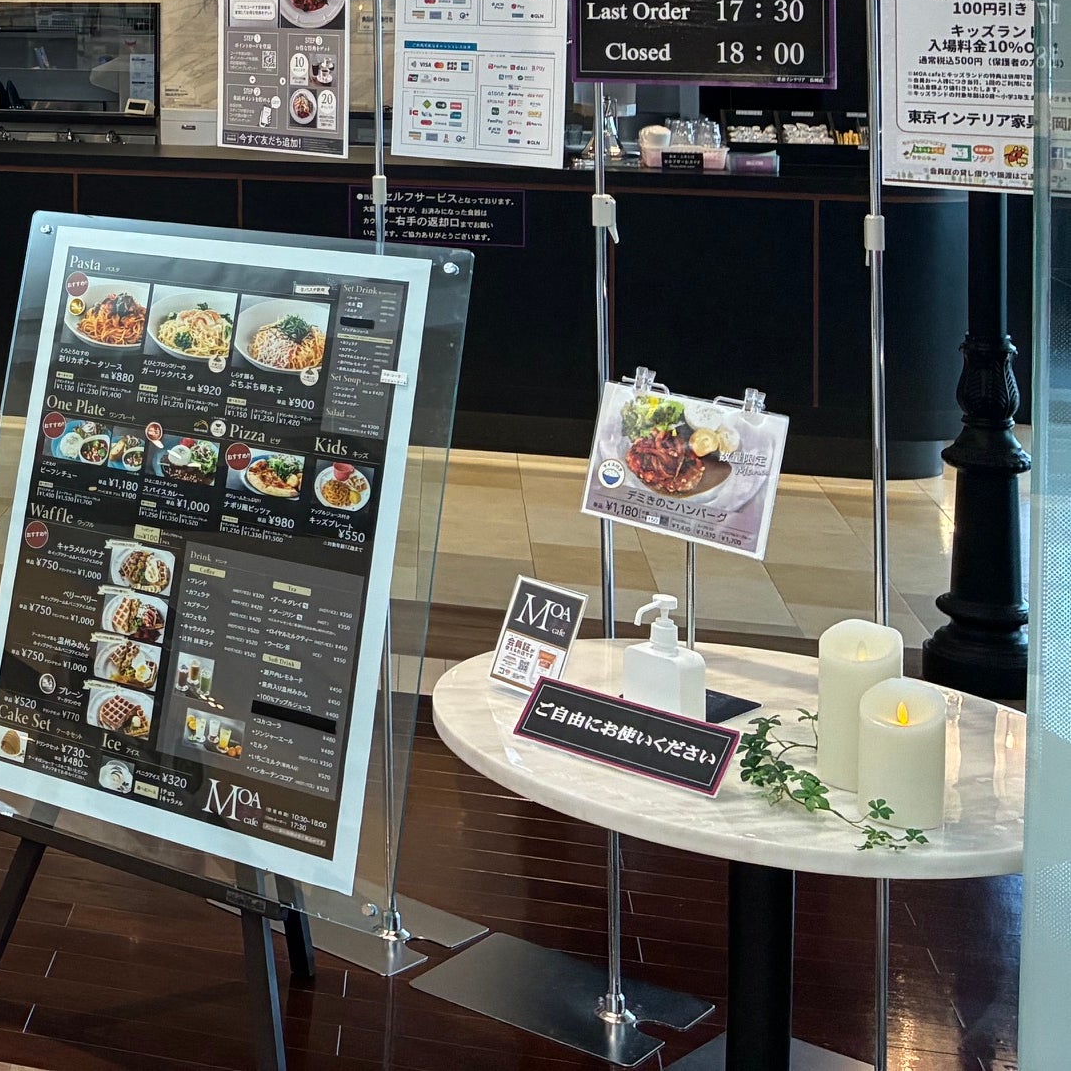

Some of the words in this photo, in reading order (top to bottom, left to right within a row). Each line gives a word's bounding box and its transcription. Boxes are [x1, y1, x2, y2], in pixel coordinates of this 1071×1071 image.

[587, 2, 628, 20] Last
[633, 2, 690, 20] Order
[605, 43, 671, 61] Closed
[295, 57, 304, 67] 10
[322, 94, 333, 104] 20
[70, 255, 101, 271] Pasta
[111, 371, 134, 383] ¥880
[197, 384, 222, 396] ¥920
[47, 395, 72, 411] One
[77, 399, 106, 417] Plate
[288, 397, 314, 410] ¥900
[230, 423, 265, 443] Pizza
[314, 436, 348, 456] Kids
[109, 478, 138, 492] ¥1,180
[30, 502, 73, 524] Waffle
[176, 499, 211, 513] ¥1,000
[605, 501, 638, 518] ¥1,180
[627, 490, 727, 523] デミきのこハンバーグ
[268, 515, 295, 529] ¥980
[338, 529, 365, 543] ¥550
[36, 557, 59, 571] ¥750
[77, 568, 102, 580] ¥1,000
[29, 603, 52, 616] ¥750
[70, 614, 94, 626] ¥1,000
[514, 593, 572, 632] MOA
[551, 627, 566, 637] cafe
[21, 648, 44, 662] ¥750
[63, 660, 87, 673] ¥1,000
[14, 695, 37, 710] ¥520
[62, 709, 80, 722] ¥770
[31, 713, 51, 731] Set
[102, 732, 122, 752] Ice
[535, 701, 716, 765] ご自由にお使いください
[162, 773, 187, 789] ¥320
[202, 778, 262, 822] MOA
[243, 816, 259, 827] cafe
